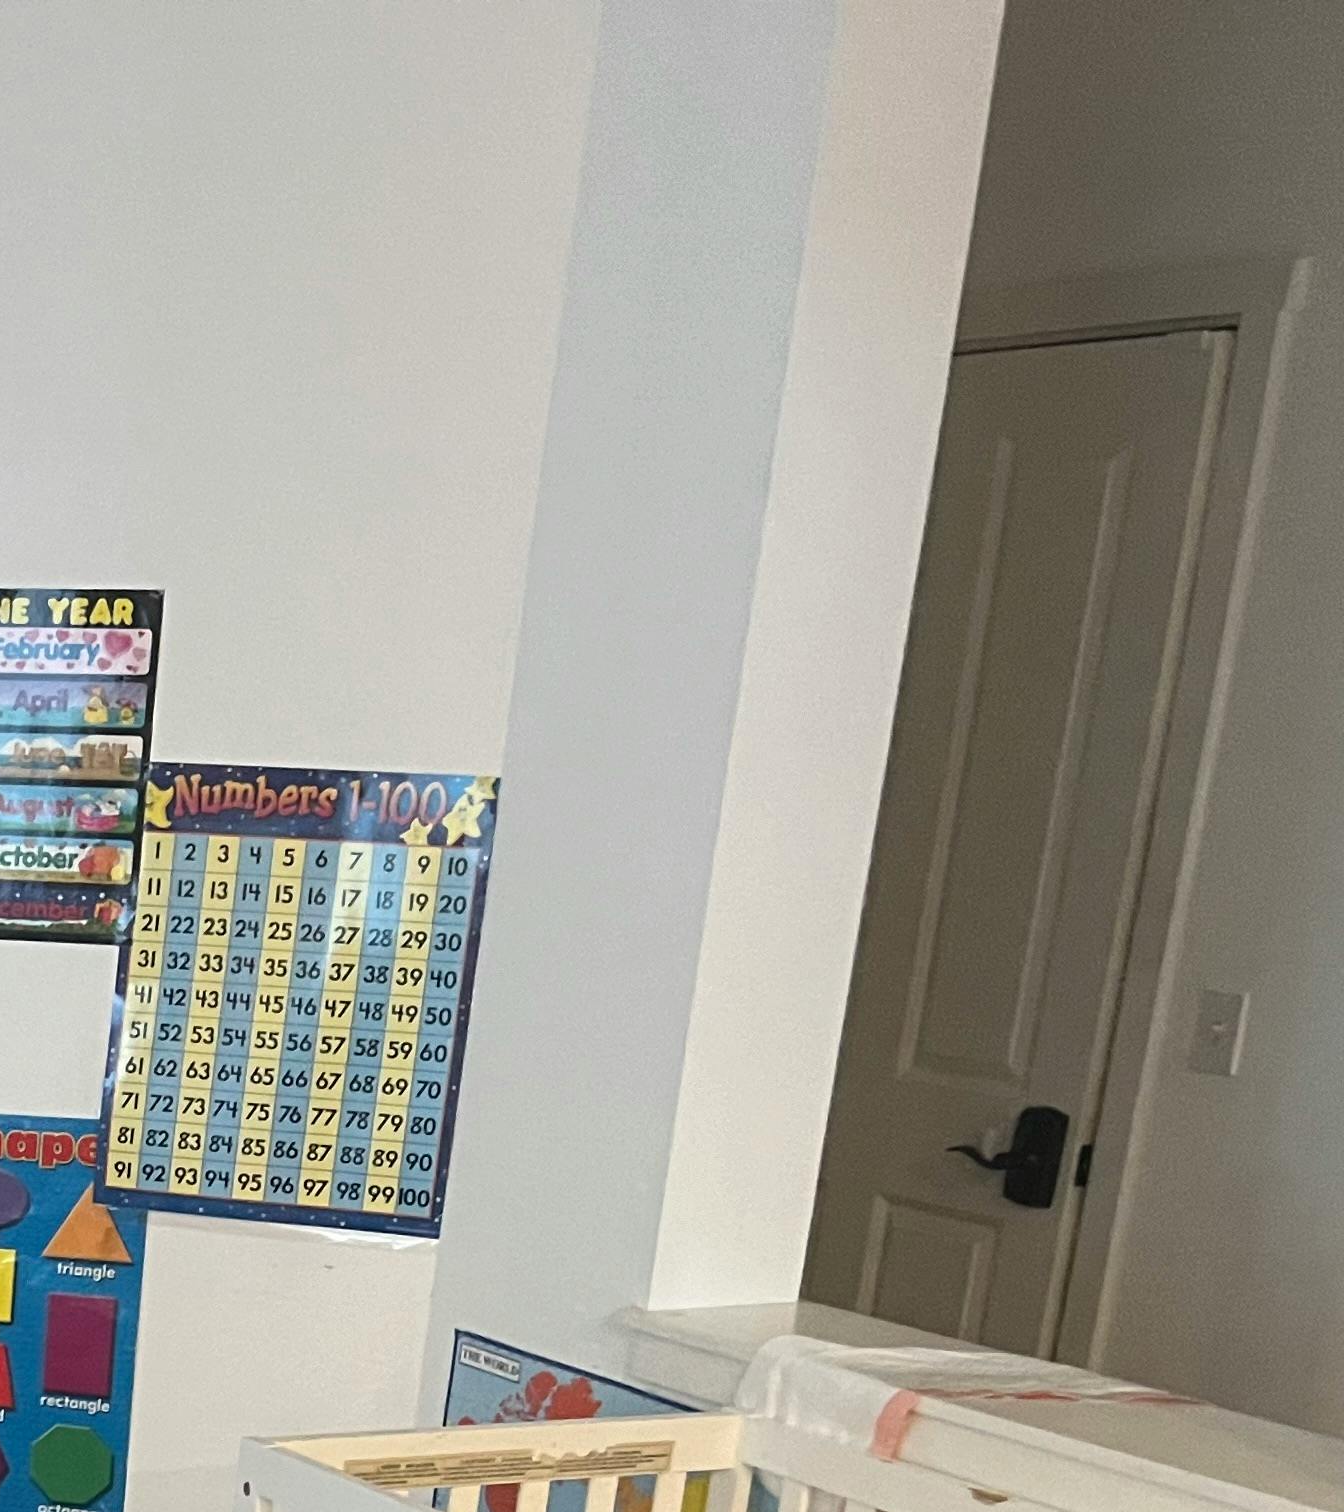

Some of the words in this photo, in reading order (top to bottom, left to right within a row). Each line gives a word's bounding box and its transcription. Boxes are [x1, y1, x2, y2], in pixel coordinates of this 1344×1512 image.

[47, 598, 134, 626] YEAR
[14, 688, 69, 717] April
[14, 742, 66, 763] June
[174, 773, 338, 819] Numbers
[349, 780, 447, 826] 1-100
[141, 913, 161, 932] 21
[170, 915, 195, 935] 22
[203, 917, 227, 937] 23
[234, 919, 260, 939] 24
[267, 921, 293, 941] 25
[300, 923, 326, 943] 26
[334, 925, 361, 945] 27
[367, 928, 393, 948] 28
[400, 930, 428, 950] 29
[434, 932, 462, 952] 30
[129, 1020, 148, 1039] 51
[157, 1023, 182, 1042] 52
[190, 1025, 215, 1045] 53
[221, 1027, 247, 1047] 54
[254, 1030, 280, 1050] 55
[286, 1033, 312, 1052] 56
[319, 1035, 347, 1055] 57
[353, 1038, 380, 1058] 58
[386, 1040, 413, 1060] 59
[419, 1043, 448, 1063] 60
[114, 1160, 132, 1179] 91
[142, 1163, 166, 1183] 92
[174, 1166, 198, 1186] 93
[204, 1169, 230, 1189] 94
[237, 1173, 262, 1192] 95
[269, 1175, 294, 1194] 96
[303, 1178, 329, 1197] 97
[336, 1181, 362, 1201] 98
[367, 1184, 395, 1204] 99
[398, 1187, 431, 1208] 100
[57, 1263, 116, 1282] triangle
[39, 1395, 110, 1415] rectangle
